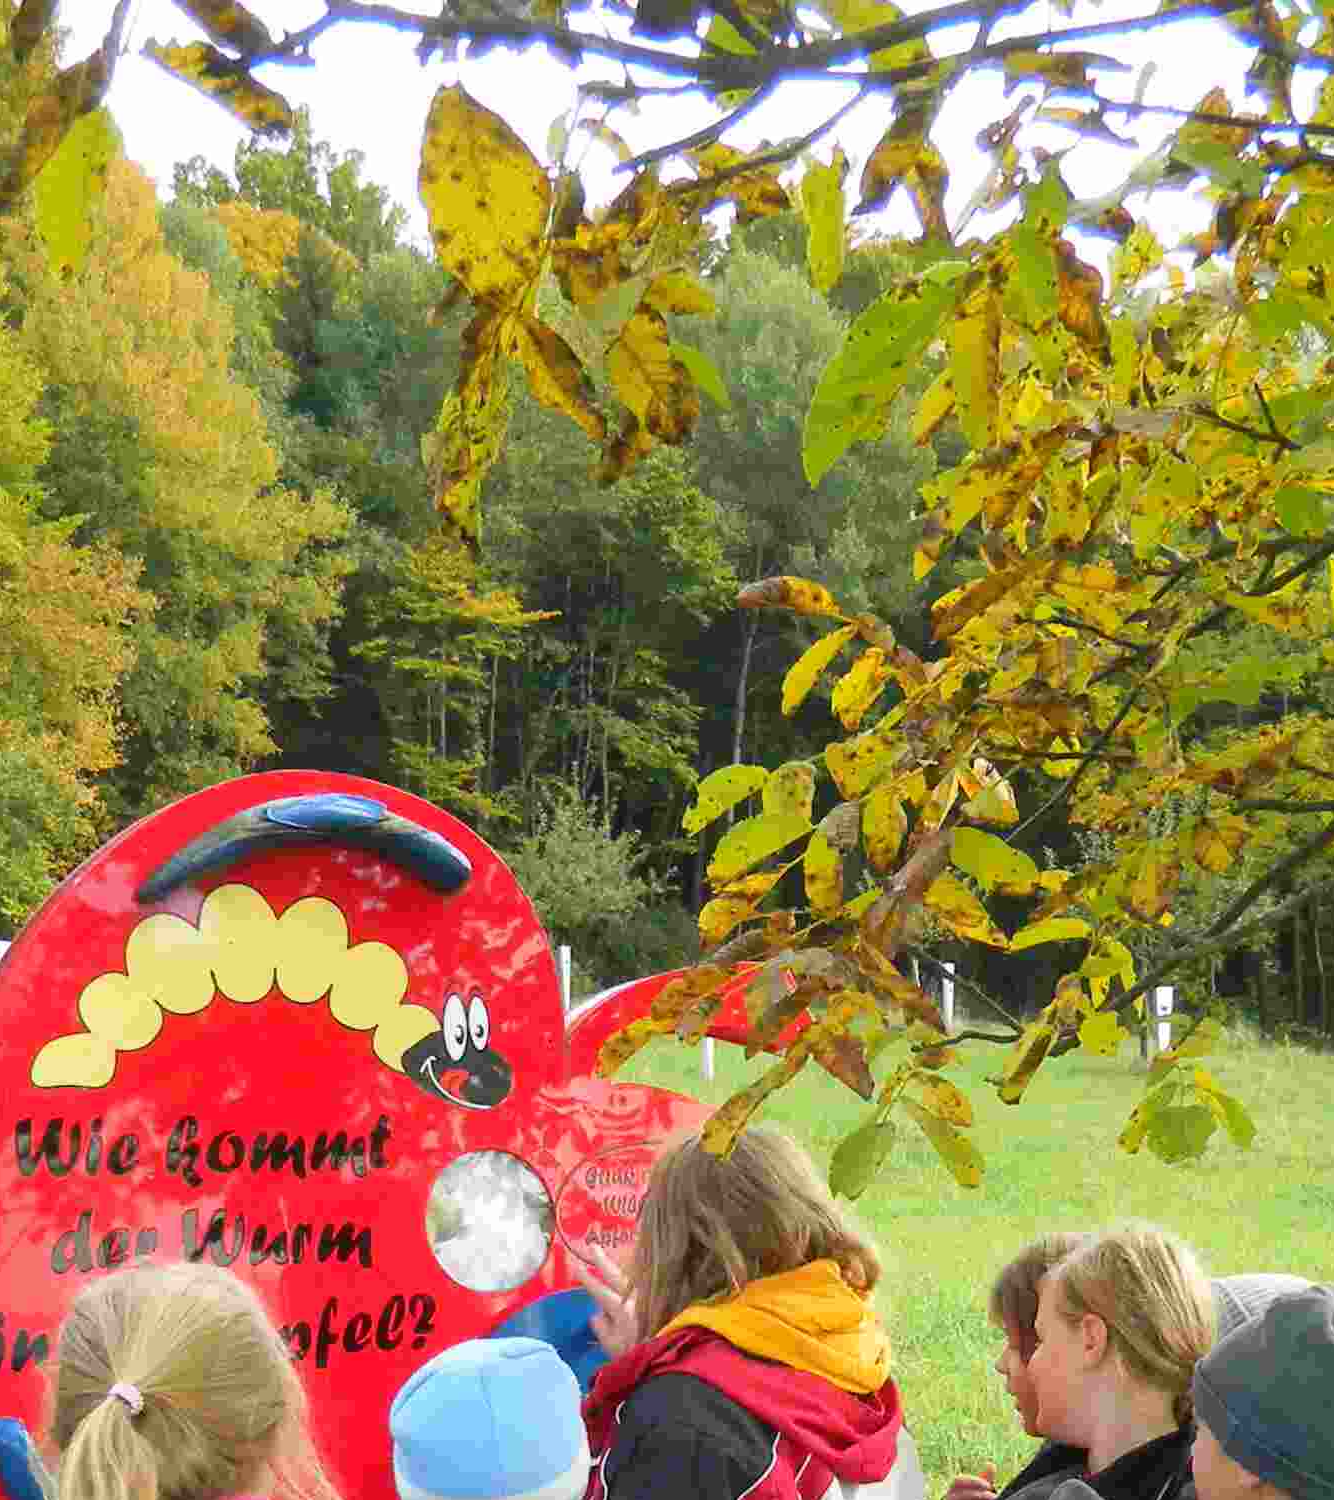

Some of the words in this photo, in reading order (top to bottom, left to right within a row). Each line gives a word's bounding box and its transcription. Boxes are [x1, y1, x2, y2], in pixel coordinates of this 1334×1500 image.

[14, 1114, 140, 1176] Wie
[167, 1114, 391, 1187] kommt
[51, 1209, 160, 1274] der
[181, 1207, 373, 1268] Wurm
[278, 1293, 436, 1368] pfel?
